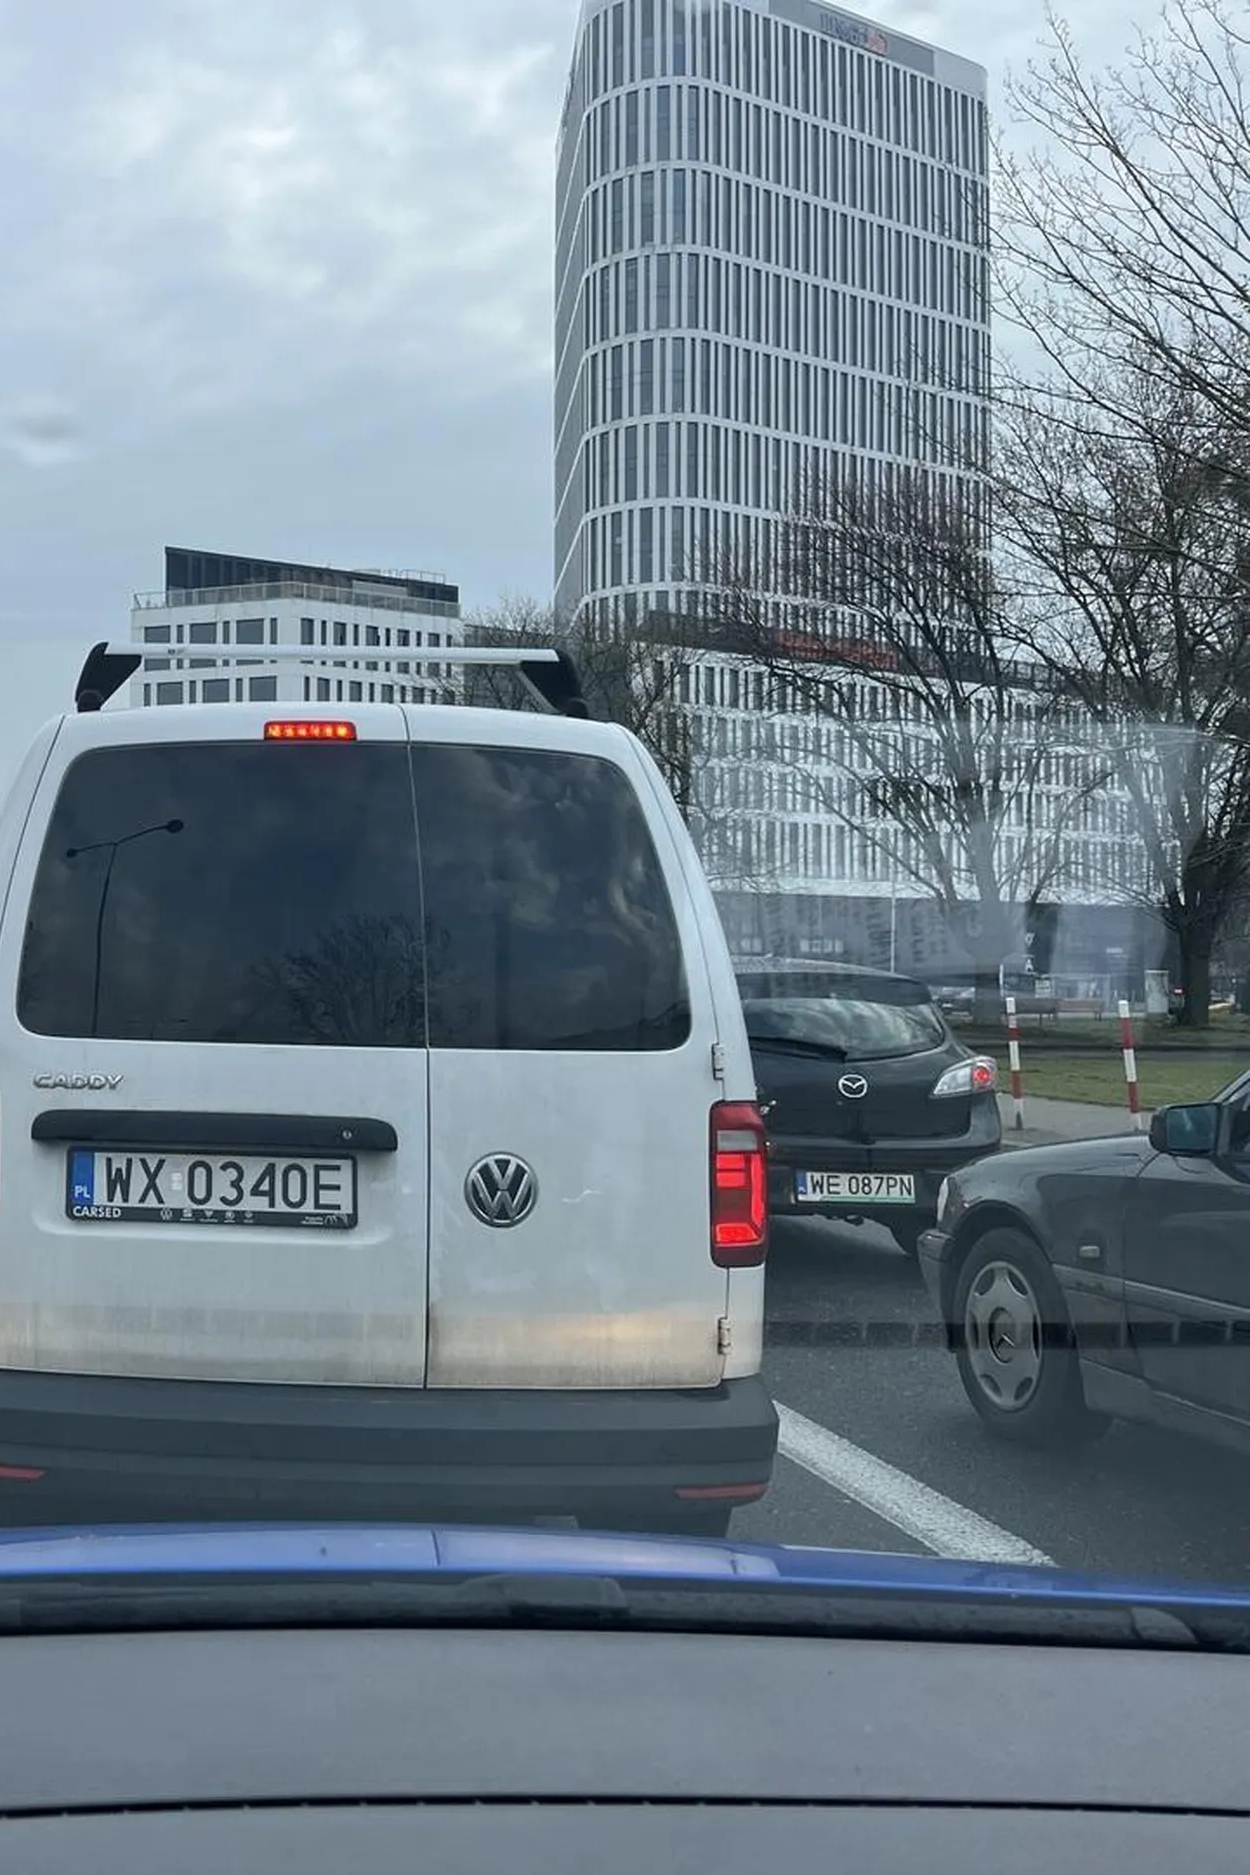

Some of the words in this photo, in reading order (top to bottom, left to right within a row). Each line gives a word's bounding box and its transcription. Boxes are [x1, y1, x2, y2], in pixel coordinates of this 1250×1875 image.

[32, 1073, 125, 1090] CADDY
[74, 1185, 91, 1199] PL
[105, 1156, 167, 1205] WX
[186, 1159, 342, 1211] 0340E
[810, 1174, 841, 1195] WE
[848, 1175, 912, 1196] 087PN
[72, 1206, 122, 1219] CARSED
